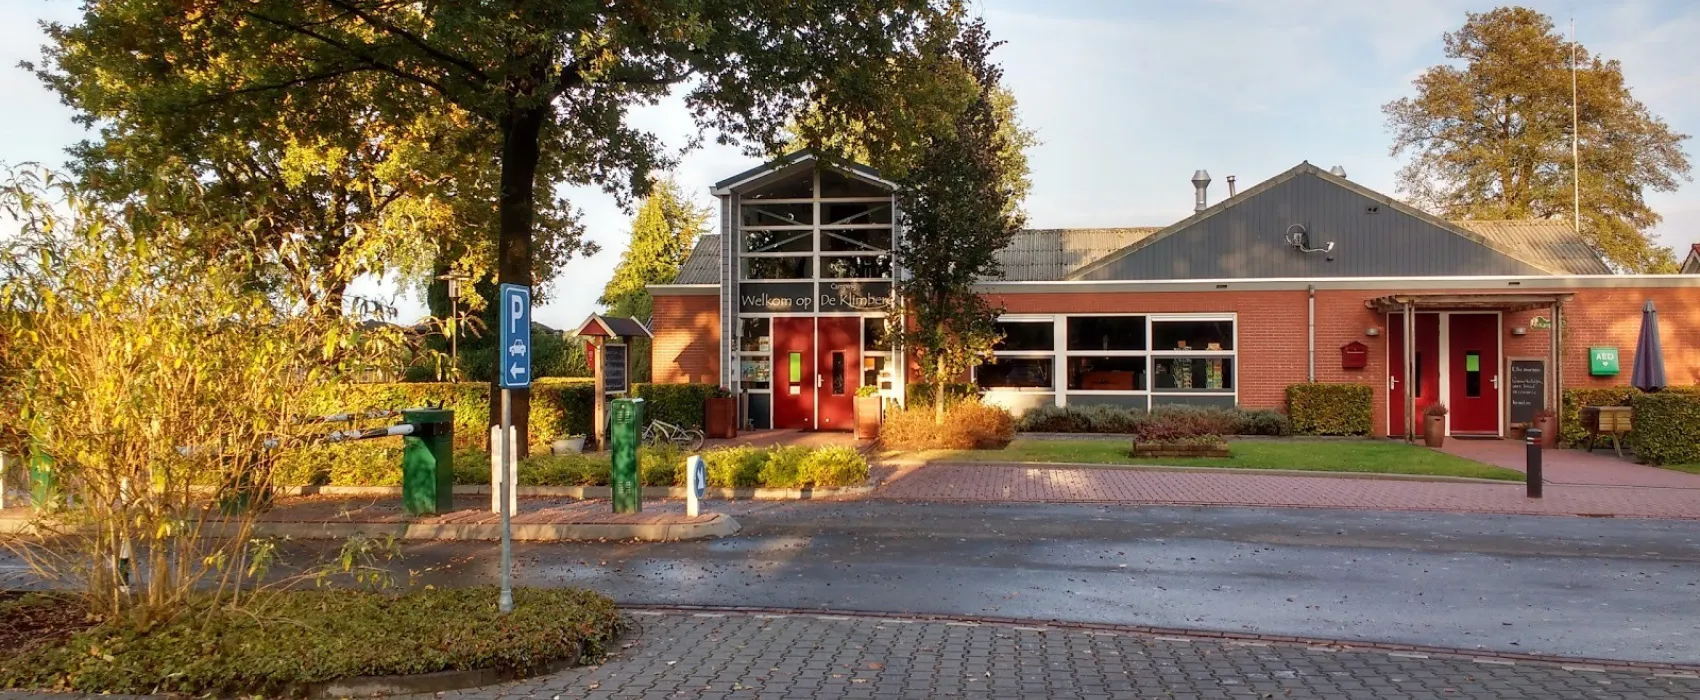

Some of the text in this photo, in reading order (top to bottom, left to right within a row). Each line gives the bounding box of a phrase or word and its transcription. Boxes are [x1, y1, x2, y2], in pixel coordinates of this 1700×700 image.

[830, 283, 857, 292] Camping
[741, 292, 793, 307] Welkom
[795, 297, 812, 310] op
[820, 294, 836, 306] De
[511, 294, 524, 334] P
